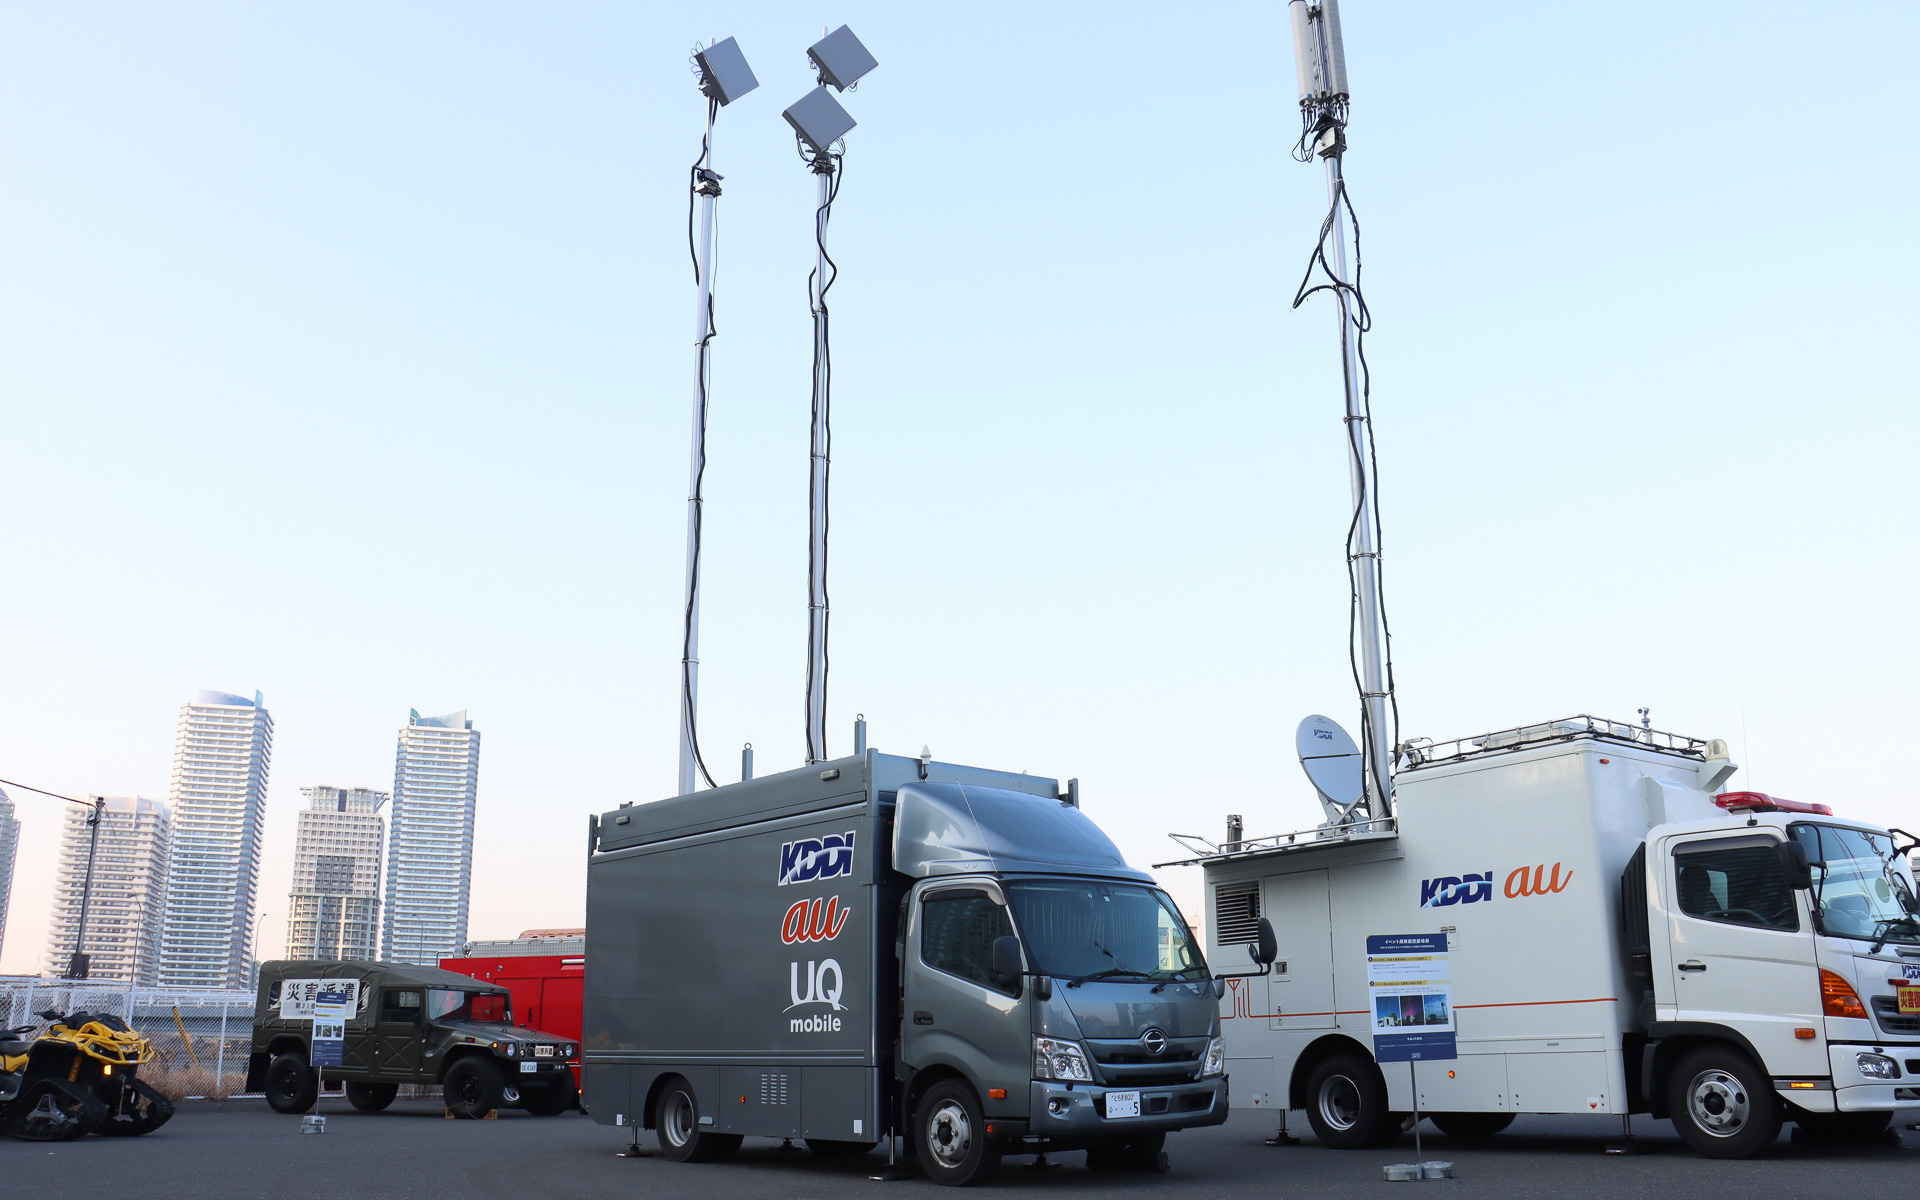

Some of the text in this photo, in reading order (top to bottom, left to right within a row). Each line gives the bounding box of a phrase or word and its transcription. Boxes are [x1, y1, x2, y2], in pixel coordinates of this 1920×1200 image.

[778, 830, 856, 886] KDDI
[1420, 862, 1573, 908] KDDI au
[781, 895, 851, 945] au
[791, 958, 843, 1011] UQ
[790, 1014, 842, 1033] mobile
